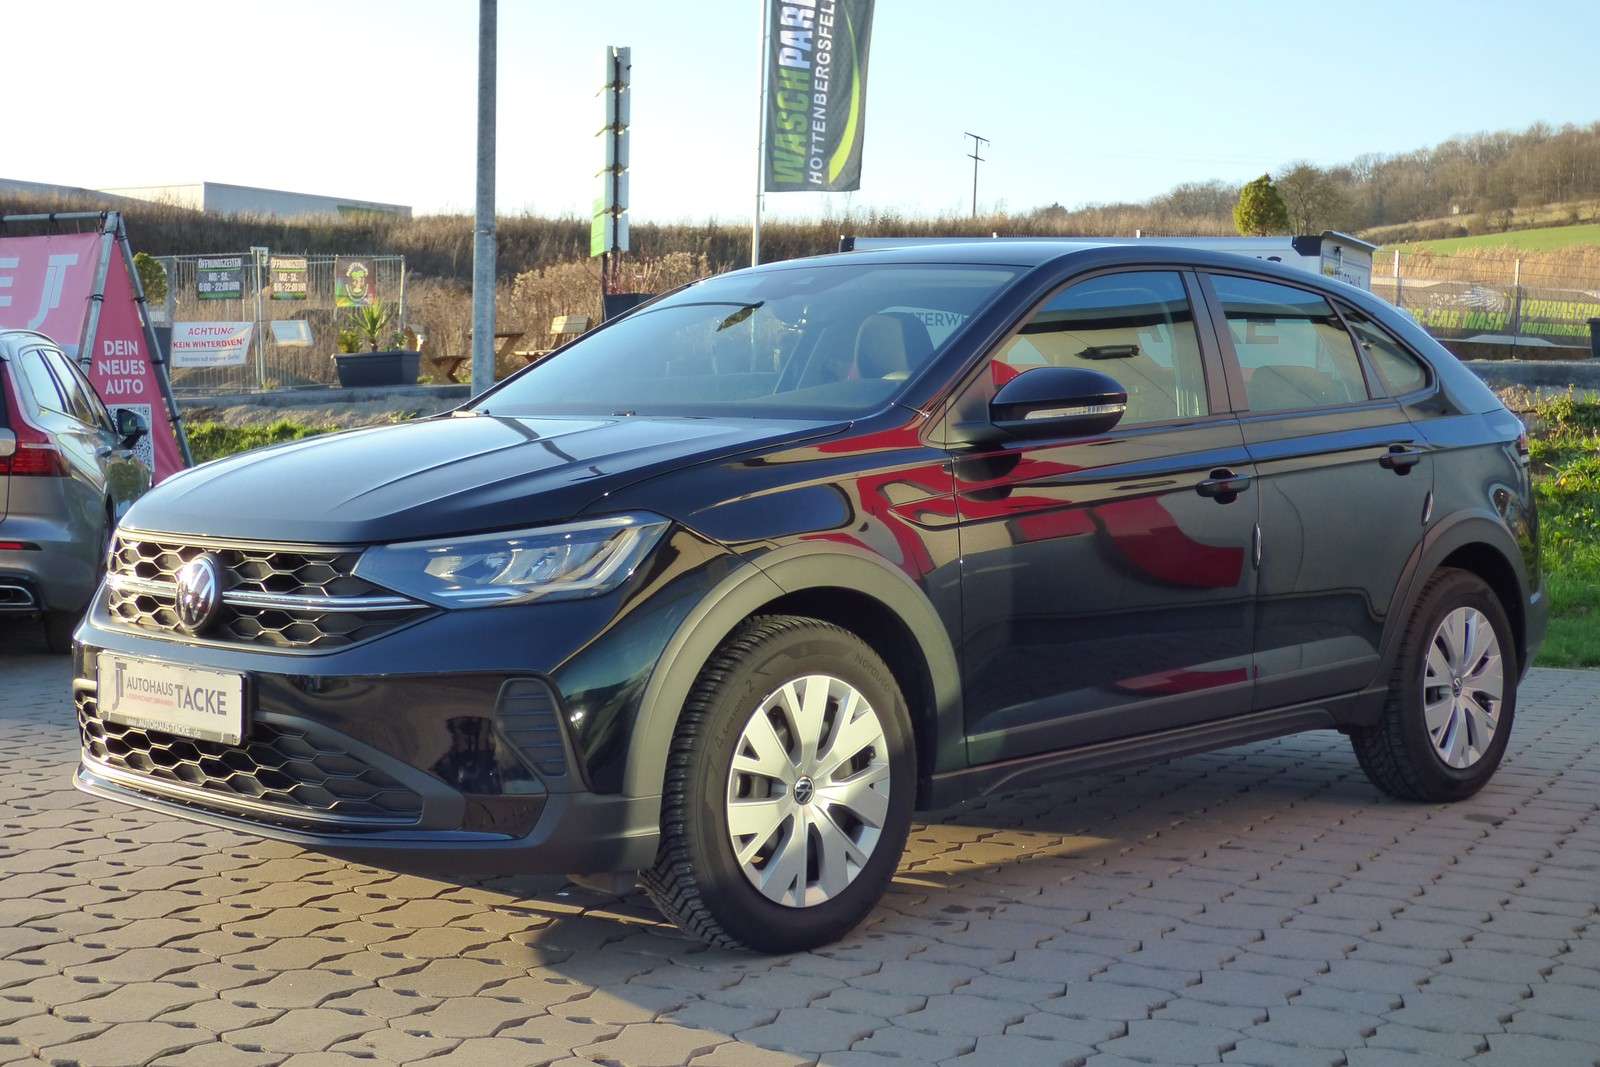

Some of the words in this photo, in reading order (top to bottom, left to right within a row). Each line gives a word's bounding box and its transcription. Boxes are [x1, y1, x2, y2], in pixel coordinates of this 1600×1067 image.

[809, 0, 836, 184] HOTTENBERGSFEL
[104, 340, 139, 356] DEIN
[99, 359, 146, 376] NEUES
[106, 379, 144, 394] AUTO
[126, 676, 174, 697] AUTOHAUS
[175, 684, 227, 716] TACKE
